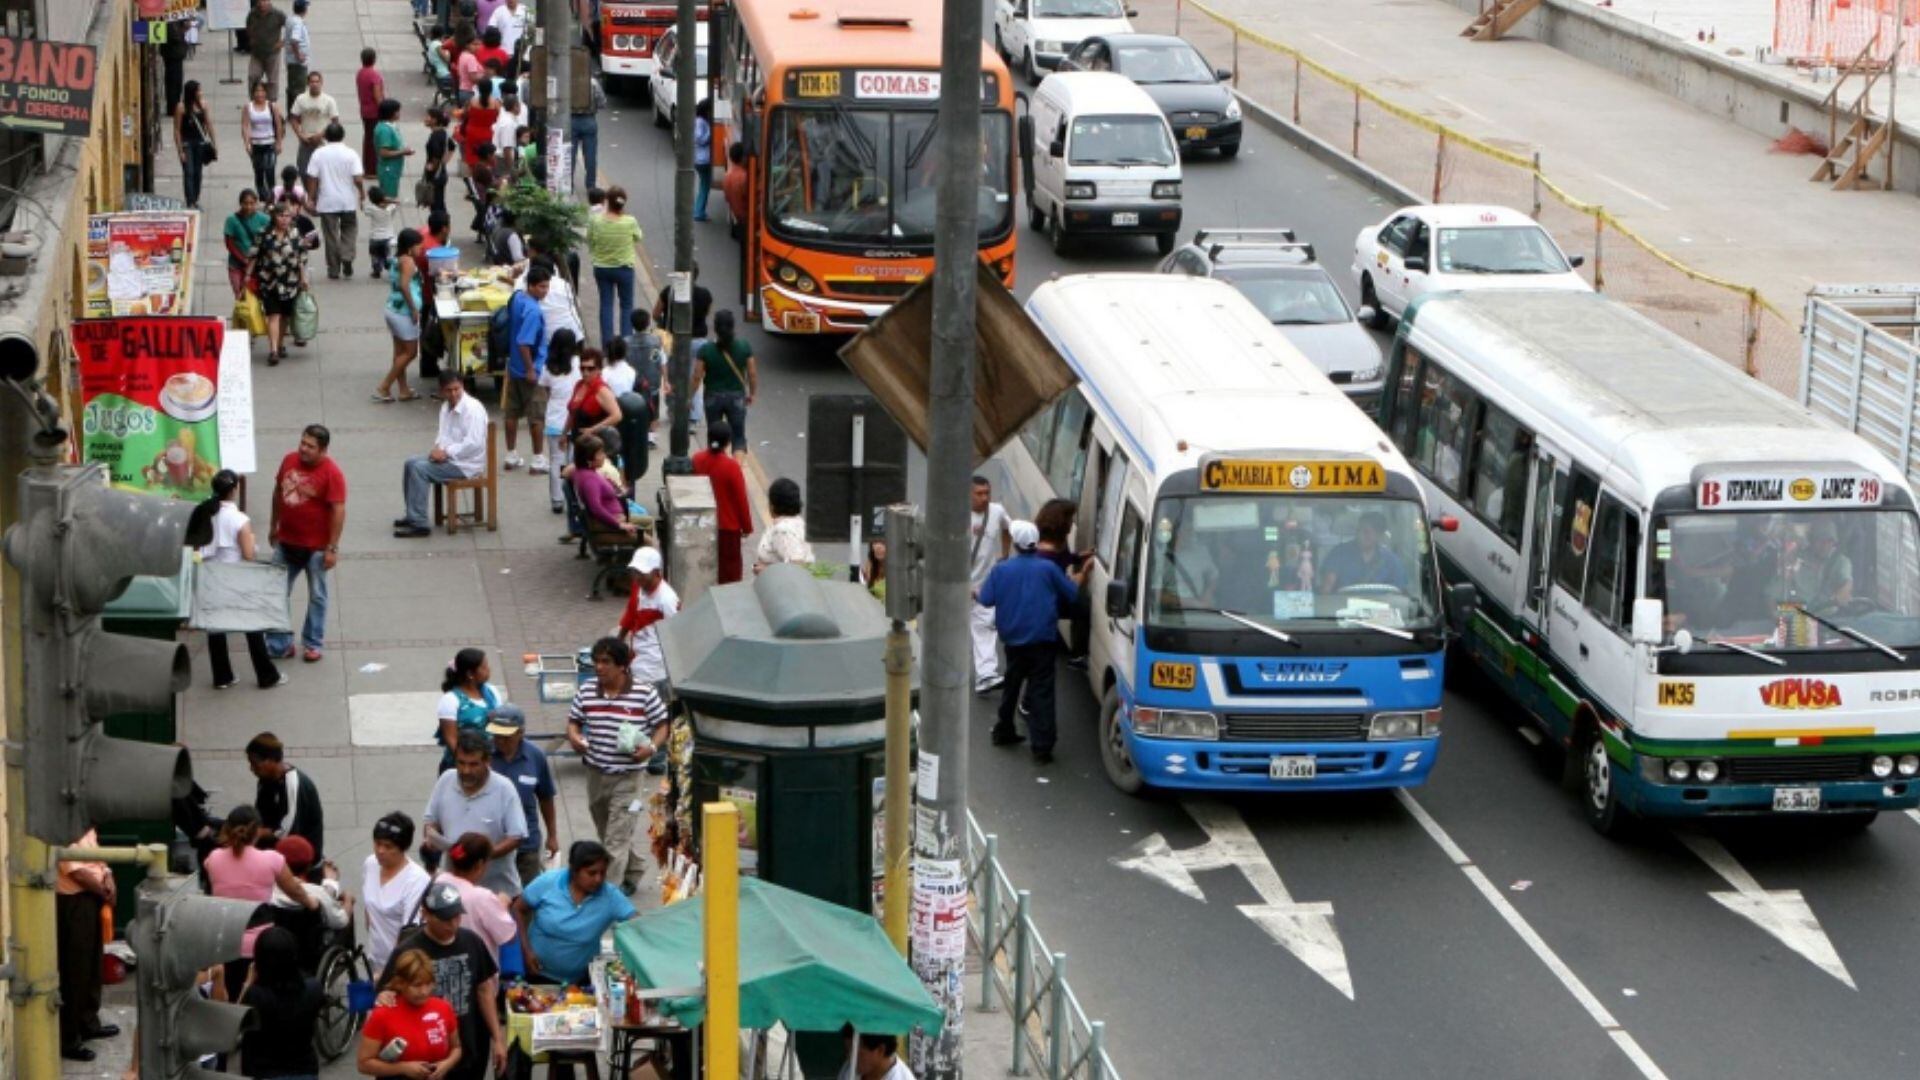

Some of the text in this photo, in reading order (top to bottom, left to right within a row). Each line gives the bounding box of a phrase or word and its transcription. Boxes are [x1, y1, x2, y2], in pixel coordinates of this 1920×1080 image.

[18, 84, 70, 103] FONDO
[25, 101, 90, 120] DERECHA
[90, 343, 108, 362] DE
[121, 325, 220, 360] GALLINA
[84, 402, 157, 438] Jugos
[1317, 466, 1379, 487] LIMA
[1702, 481, 1721, 506] B
[1727, 479, 1784, 501] VENTANILLA
[1821, 479, 1855, 499] LINCE
[1859, 479, 1880, 503] 39
[1759, 678, 1842, 709] VIPUSA
